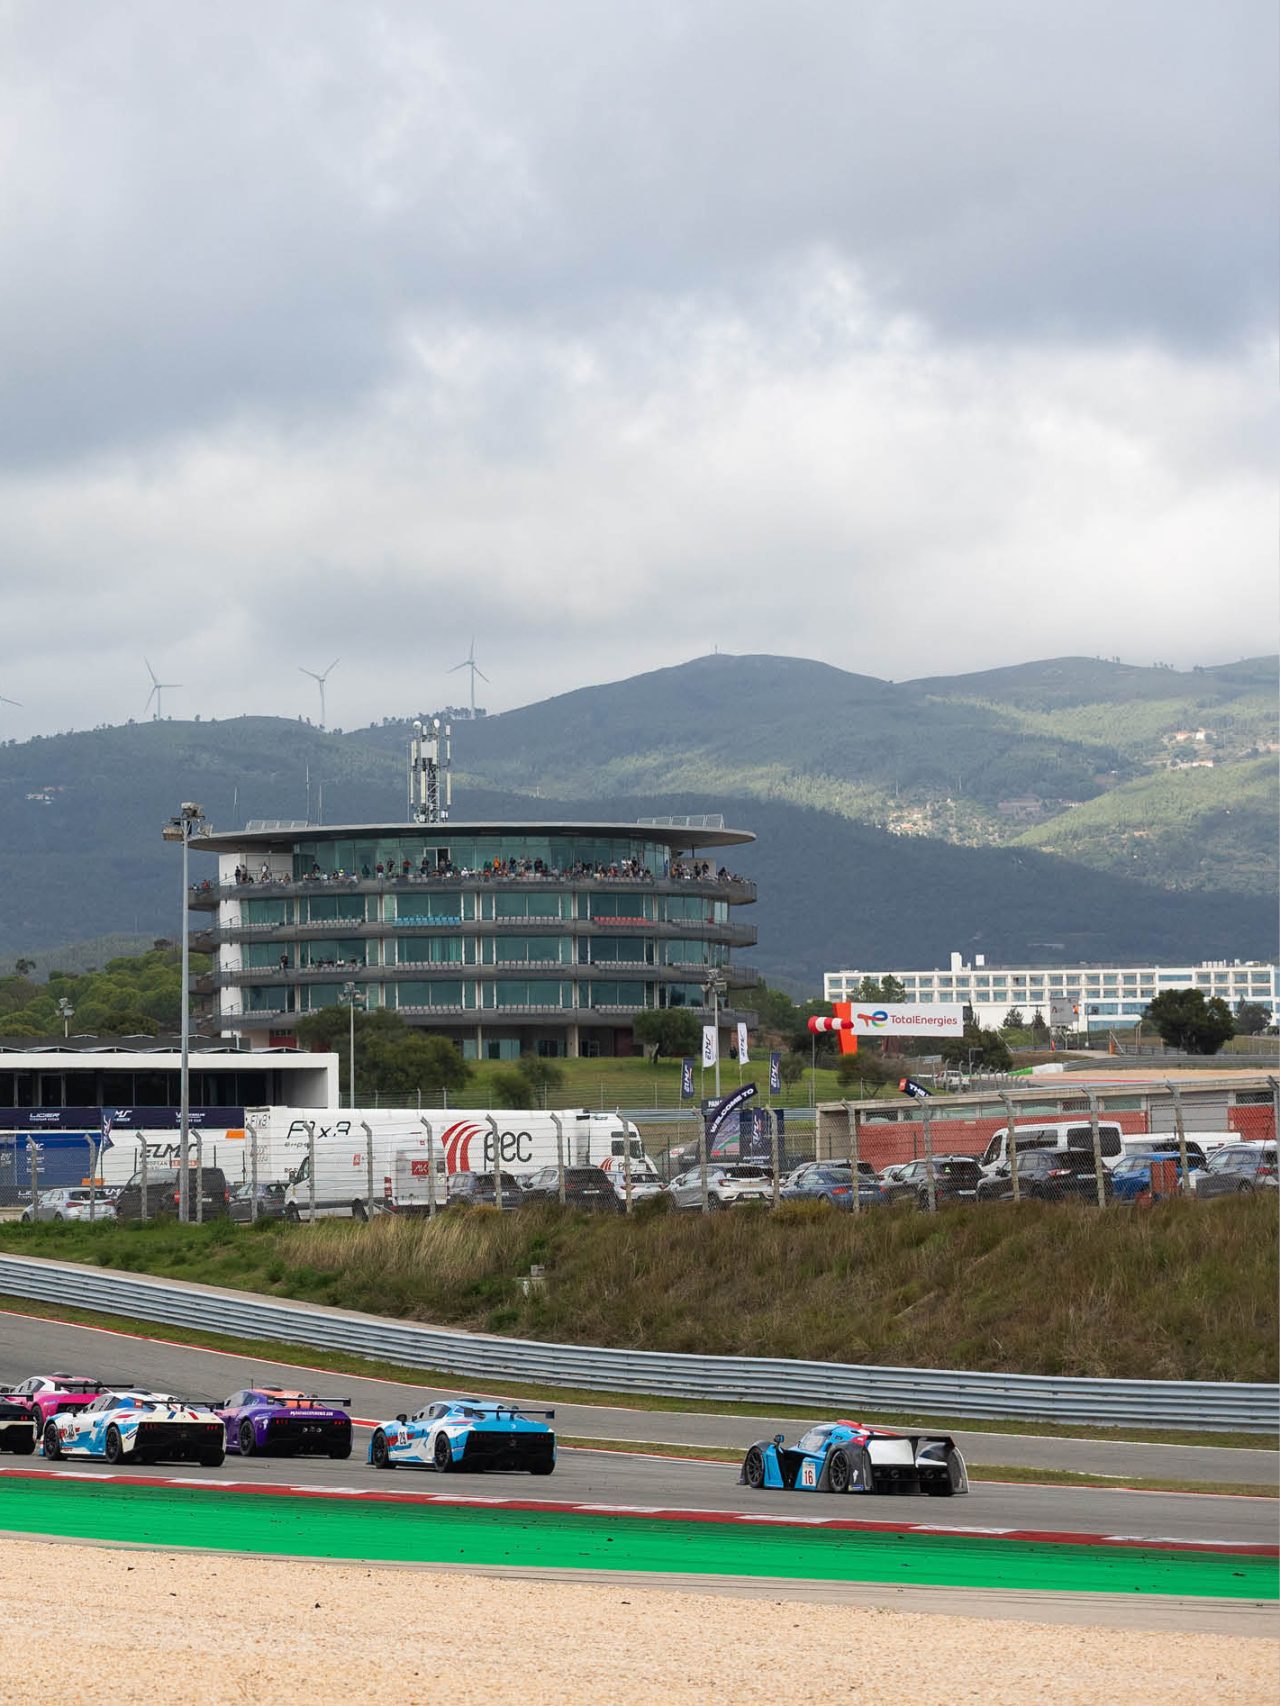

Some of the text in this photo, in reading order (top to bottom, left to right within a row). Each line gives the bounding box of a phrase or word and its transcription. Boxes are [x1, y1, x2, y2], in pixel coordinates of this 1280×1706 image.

[889, 1015, 958, 1027] TotalEnergies
[710, 1088, 754, 1133] WELCOME TO
[804, 1470, 814, 1485] 16
